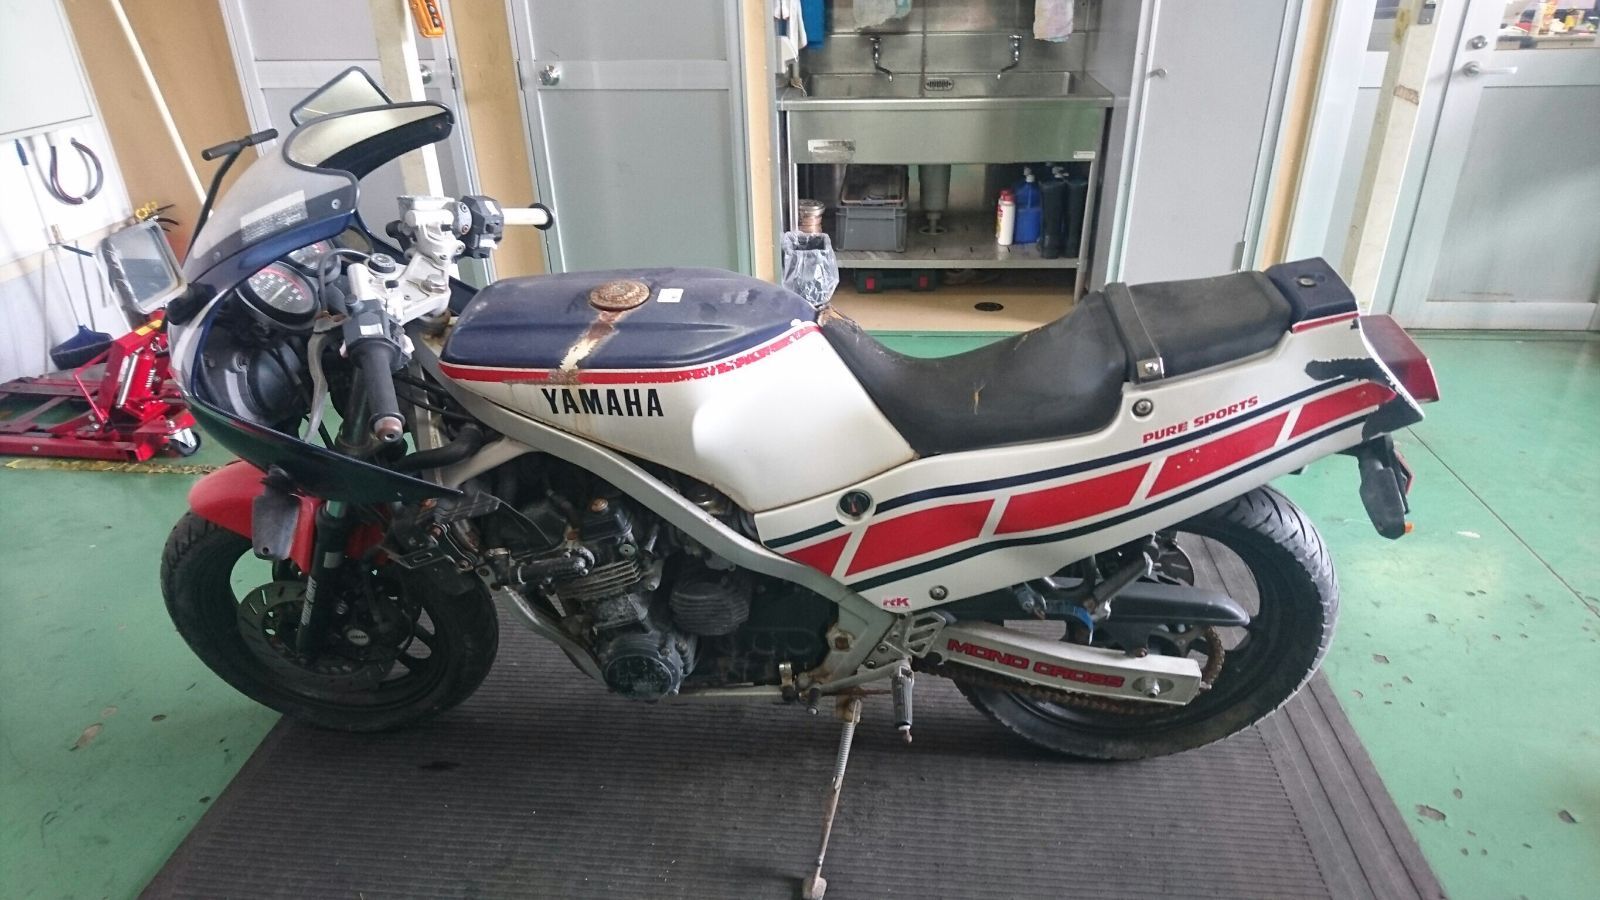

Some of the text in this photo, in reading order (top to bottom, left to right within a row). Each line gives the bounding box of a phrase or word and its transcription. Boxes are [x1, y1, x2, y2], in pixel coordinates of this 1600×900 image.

[541, 388, 664, 417] YAMAHA
[1143, 396, 1258, 444] PURE SPORTS
[947, 638, 1126, 688] MONO CROSS
